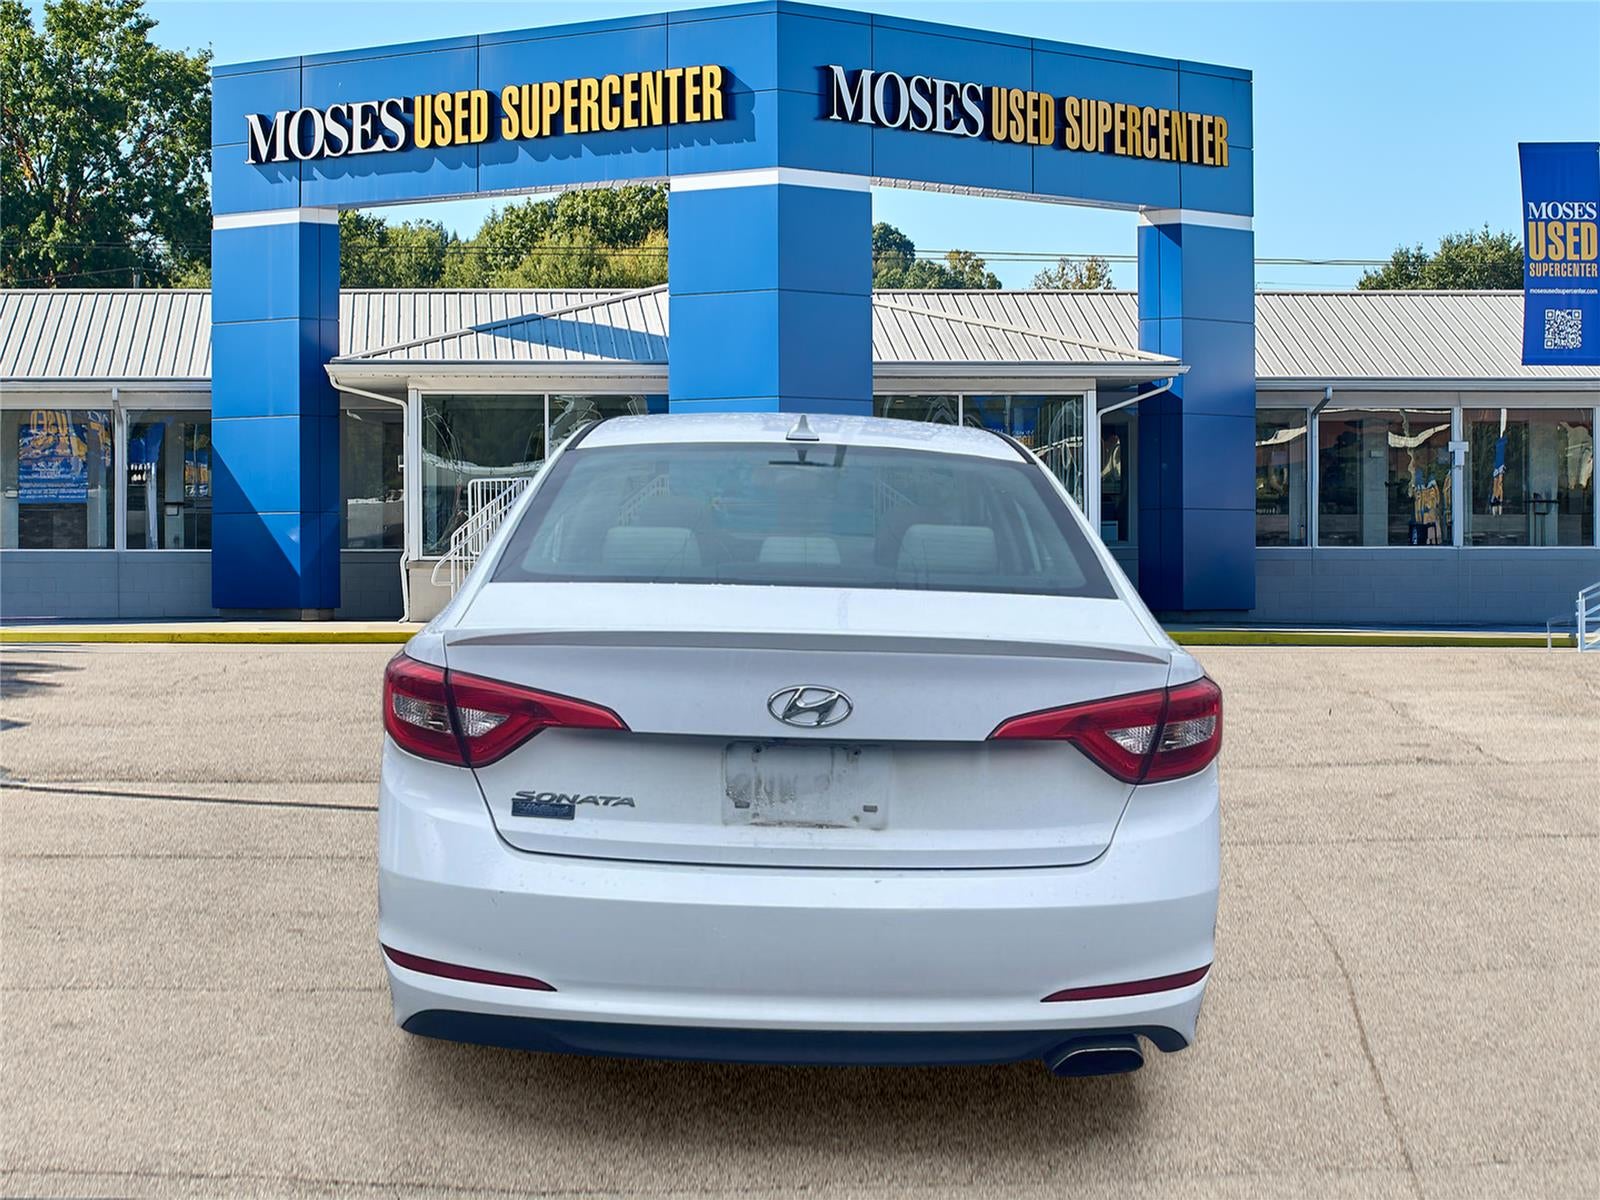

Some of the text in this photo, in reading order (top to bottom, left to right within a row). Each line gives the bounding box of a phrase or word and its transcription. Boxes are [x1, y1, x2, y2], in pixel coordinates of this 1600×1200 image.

[245, 64, 724, 165] MOSES USED SUPERCENTER
[828, 64, 1230, 168] MOSES USED SUPERCENTER
[1527, 201, 1597, 220] MOSES
[1528, 221, 1598, 261] USED
[1529, 263, 1598, 278] SUPERCENTER
[515, 790, 636, 808] SONATA
